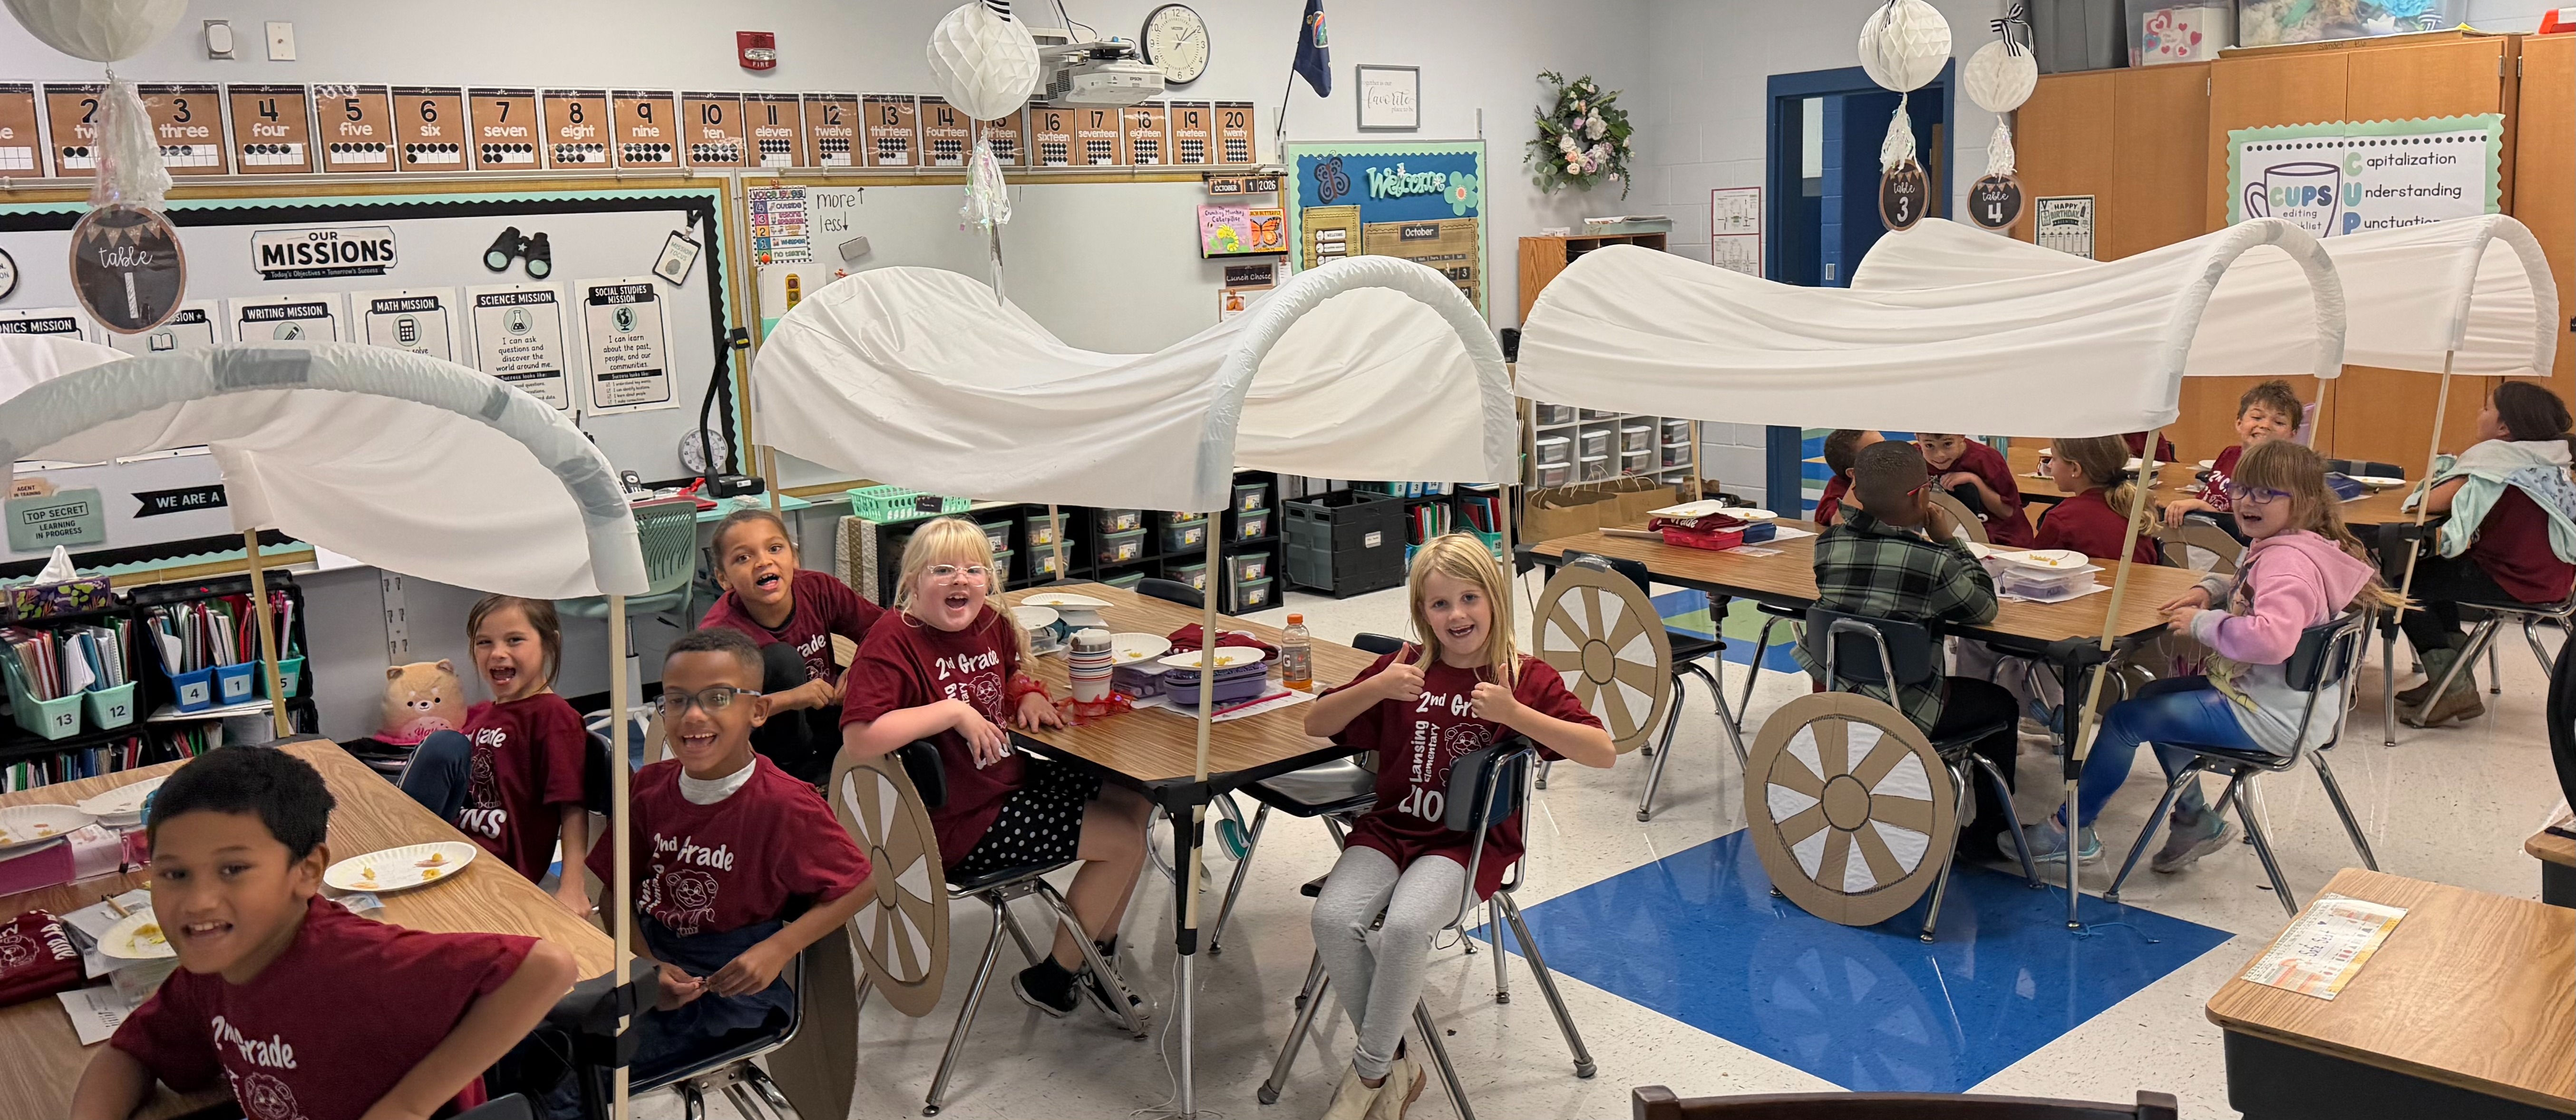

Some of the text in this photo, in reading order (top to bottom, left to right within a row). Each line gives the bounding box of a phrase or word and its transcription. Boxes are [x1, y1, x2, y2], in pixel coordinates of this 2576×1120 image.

[1172, 9, 1180, 17] 12
[1196, 25, 1201, 33] 2
[1150, 39, 1155, 48] 9
[1154, 55, 1159, 63] 8
[1165, 67, 1169, 75] 7
[1366, 86, 1415, 109] favorite
[80, 98, 98, 123] 2
[173, 98, 191, 123] 3
[260, 98, 278, 122] 4
[345, 98, 363, 122] 5
[420, 100, 438, 123] 6
[496, 101, 510, 123] 7
[569, 102, 584, 124] 8
[637, 102, 652, 124] 9
[701, 103, 722, 125] 10
[767, 105, 778, 126] 11
[823, 105, 842, 126] 12
[881, 106, 899, 126] 13
[937, 107, 954, 126] 14
[1045, 113, 1060, 131] 16
[1090, 111, 1103, 128] 17
[1137, 111, 1152, 128] 18
[1184, 111, 1198, 128] 19
[1225, 111, 1244, 128] 20
[159, 123, 209, 138] three
[253, 123, 289, 137] four
[340, 122, 373, 136] five
[420, 124, 441, 137] six
[484, 125, 527, 137] seven
[561, 124, 595, 140] eight
[632, 126, 660, 137] nine
[702, 127, 725, 139] ten
[755, 126, 793, 137] eleven
[815, 126, 852, 137] twelve
[870, 126, 913, 137] thirteen
[926, 127, 969, 137] fourteen
[1078, 129, 1118, 138] seventeen
[1130, 129, 1161, 139] eighteen
[1176, 129, 1207, 138] nineteen
[1223, 128, 1248, 138] twenty
[1037, 132, 1069, 142] sixteen
[2344, 152, 2457, 176] C apitalization
[1249, 182, 1253, 191] 1
[1258, 180, 1276, 190] 2026
[1366, 162, 1446, 199] Welcome
[1894, 182, 1915, 194] table
[2343, 182, 2462, 207] U nderstanding
[817, 193, 855, 209] more
[1982, 191, 2009, 201] table
[2269, 185, 2333, 208] CUPS
[756, 202, 764, 213] 4
[1897, 196, 1909, 222] 3
[1988, 202, 2003, 223] 4
[2050, 210, 2080, 219] BIRTHDAY
[2282, 209, 2317, 219] editing
[758, 214, 766, 224] 3
[819, 215, 843, 233] less
[2343, 212, 2361, 235] P
[309, 232, 339, 241] OUR
[759, 227, 766, 236] 2
[1405, 228, 1434, 237] October
[671, 242, 693, 256] MISSION
[760, 239, 768, 249] 1
[98, 245, 153, 269] table
[262, 239, 394, 267] MISSIONS
[270, 271, 292, 279] Today's
[293, 270, 321, 279] Objectives
[1226, 273, 1249, 282] Lunch
[1250, 272, 1272, 281] Choice
[1462, 268, 1468, 277] 3
[124, 272, 139, 319] 1
[595, 285, 647, 297] SOCIAL STUDIES
[376, 298, 435, 312] MATH MISSION
[480, 292, 552, 306] SCIENCE MISSION
[608, 295, 636, 304] MISSION
[246, 305, 323, 320] WRITING MISSION
[0, 319, 72, 333] NICS MISSION
[628, 334, 644, 342] learn
[498, 346, 530, 355] questions
[603, 345, 622, 353] about
[624, 343, 634, 351] the
[604, 354, 626, 364] people,
[628, 352, 639, 360] and
[496, 363, 515, 372] world
[516, 361, 539, 370] around
[156, 491, 220, 508] WE ARE A
[27, 505, 84, 521] TOP SECRET
[39, 520, 76, 531] LEARNING
[46, 527, 82, 538] PROGRESS
[958, 646, 1000, 674] Grade
[1283, 654, 1291, 667] G
[234, 681, 241, 691] 1
[191, 689, 200, 699] 4
[1416, 691, 1447, 713] 2nd
[109, 705, 126, 718] 12
[56, 714, 73, 727] 13
[1409, 721, 1429, 783] Lansing
[1424, 723, 1440, 783] Elementary
[1398, 785, 1444, 822] LIO
